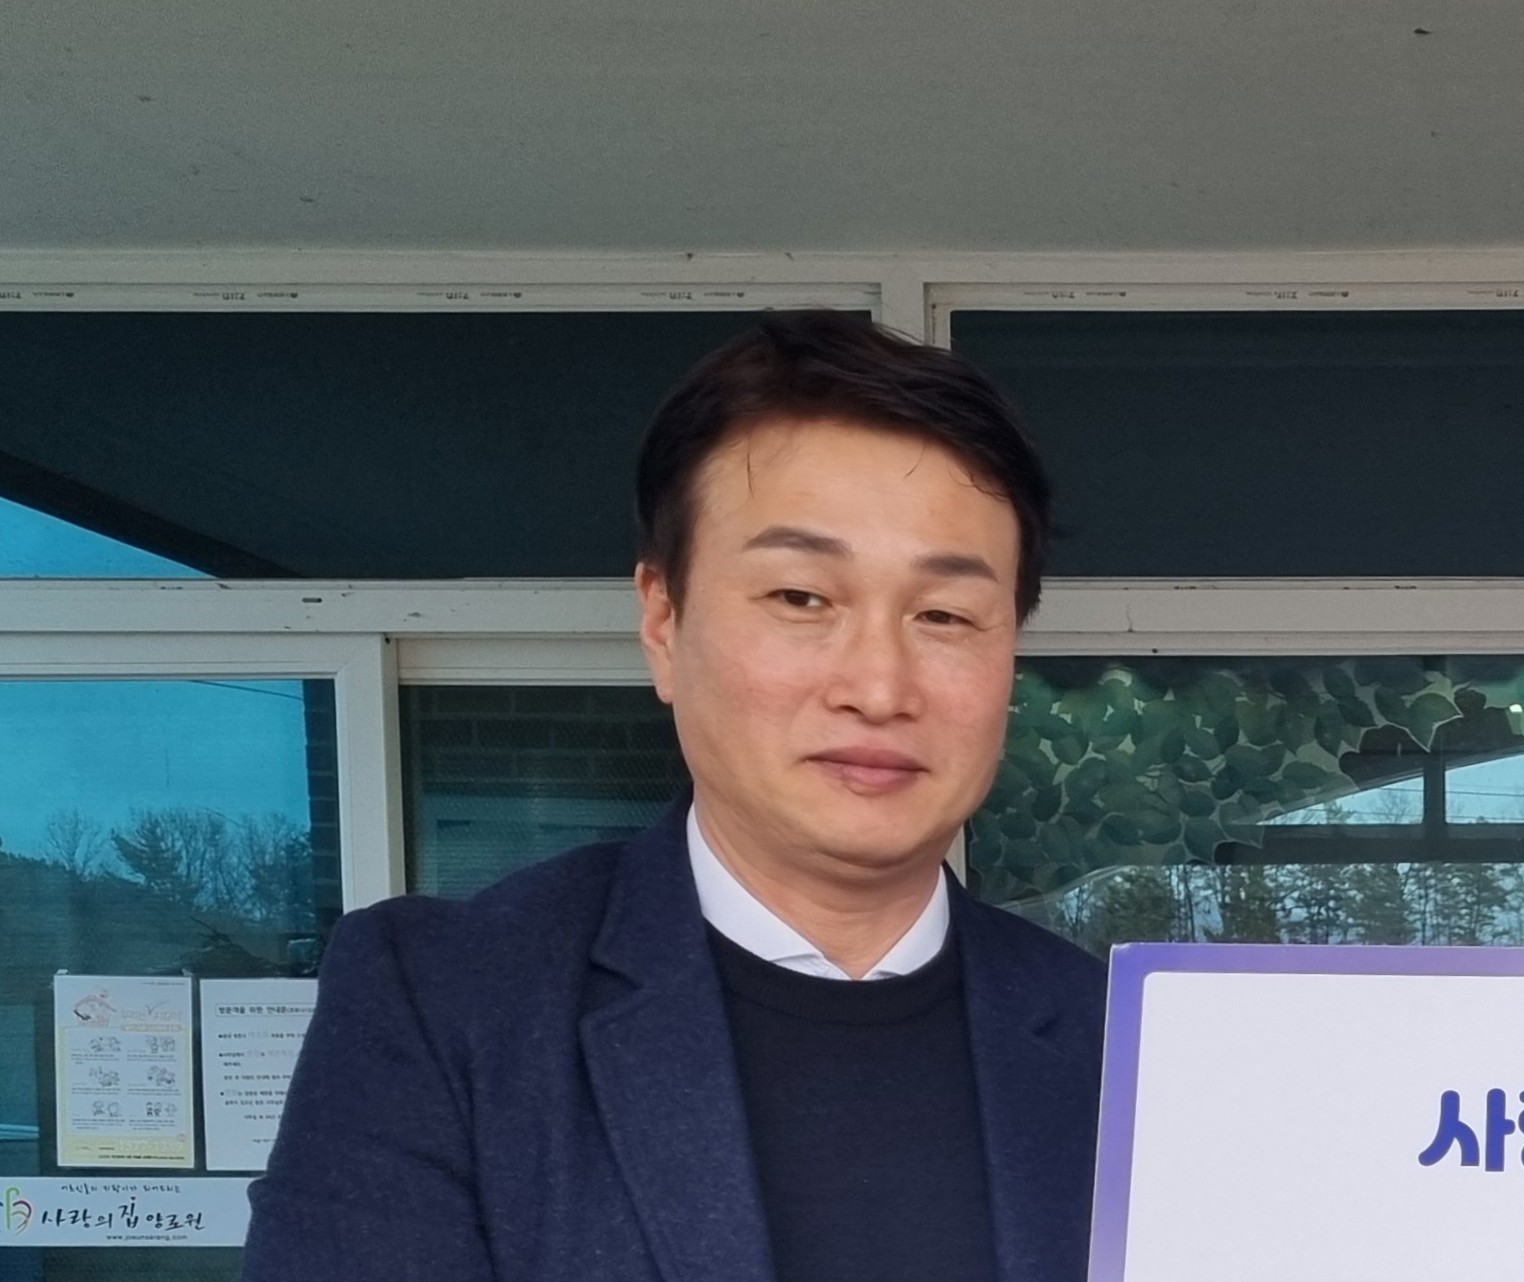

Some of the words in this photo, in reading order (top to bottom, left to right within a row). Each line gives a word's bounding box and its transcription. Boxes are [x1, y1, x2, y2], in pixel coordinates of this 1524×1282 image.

[42, 1207, 113, 1229] 사랑의
[119, 1196, 140, 1229] 집
[146, 1211, 205, 1231] 양로원
